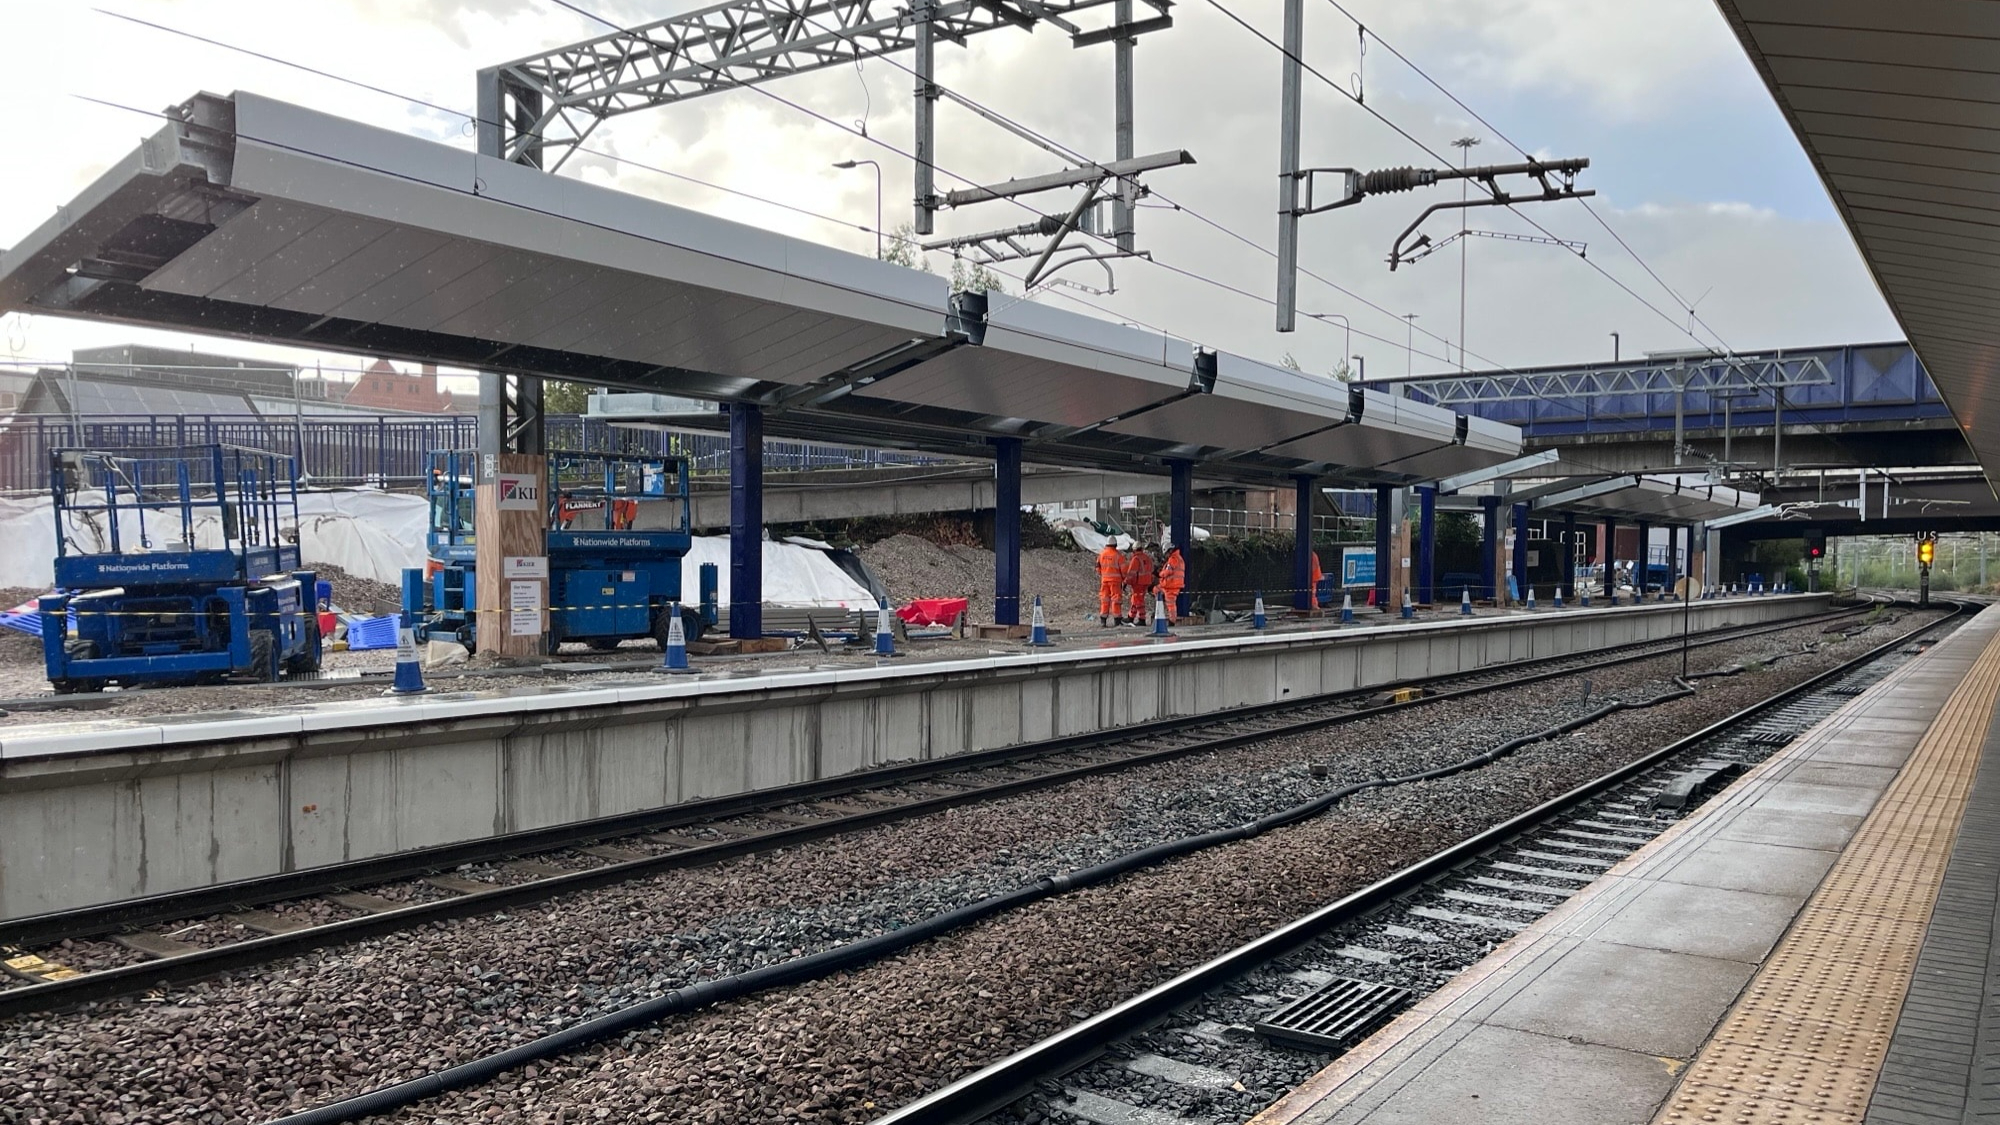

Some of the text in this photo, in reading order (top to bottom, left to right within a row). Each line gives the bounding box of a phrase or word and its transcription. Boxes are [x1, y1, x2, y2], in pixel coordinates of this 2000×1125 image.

[566, 502, 601, 510] FLANNERY
[580, 538, 650, 546] Nationwide Platforms
[106, 562, 189, 572] Nationwide Platforms
